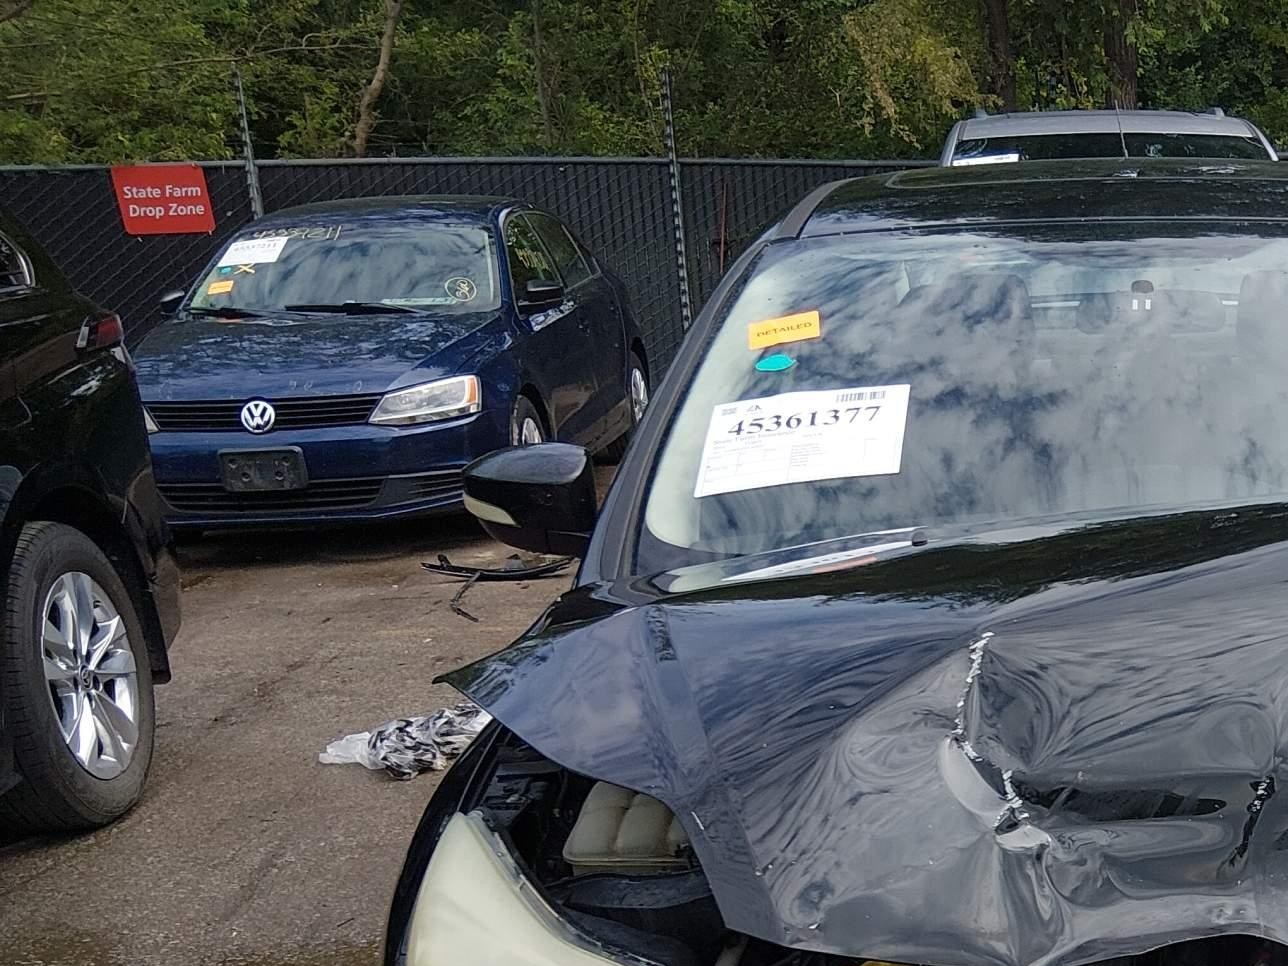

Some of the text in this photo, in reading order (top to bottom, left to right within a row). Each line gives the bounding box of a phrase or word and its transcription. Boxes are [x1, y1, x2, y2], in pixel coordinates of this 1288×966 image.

[123, 184, 201, 199] State Farm
[129, 203, 205, 219] Drop Zone
[756, 321, 813, 338] DETAILED
[242, 401, 275, 432] VW
[728, 405, 880, 436] 45361377
